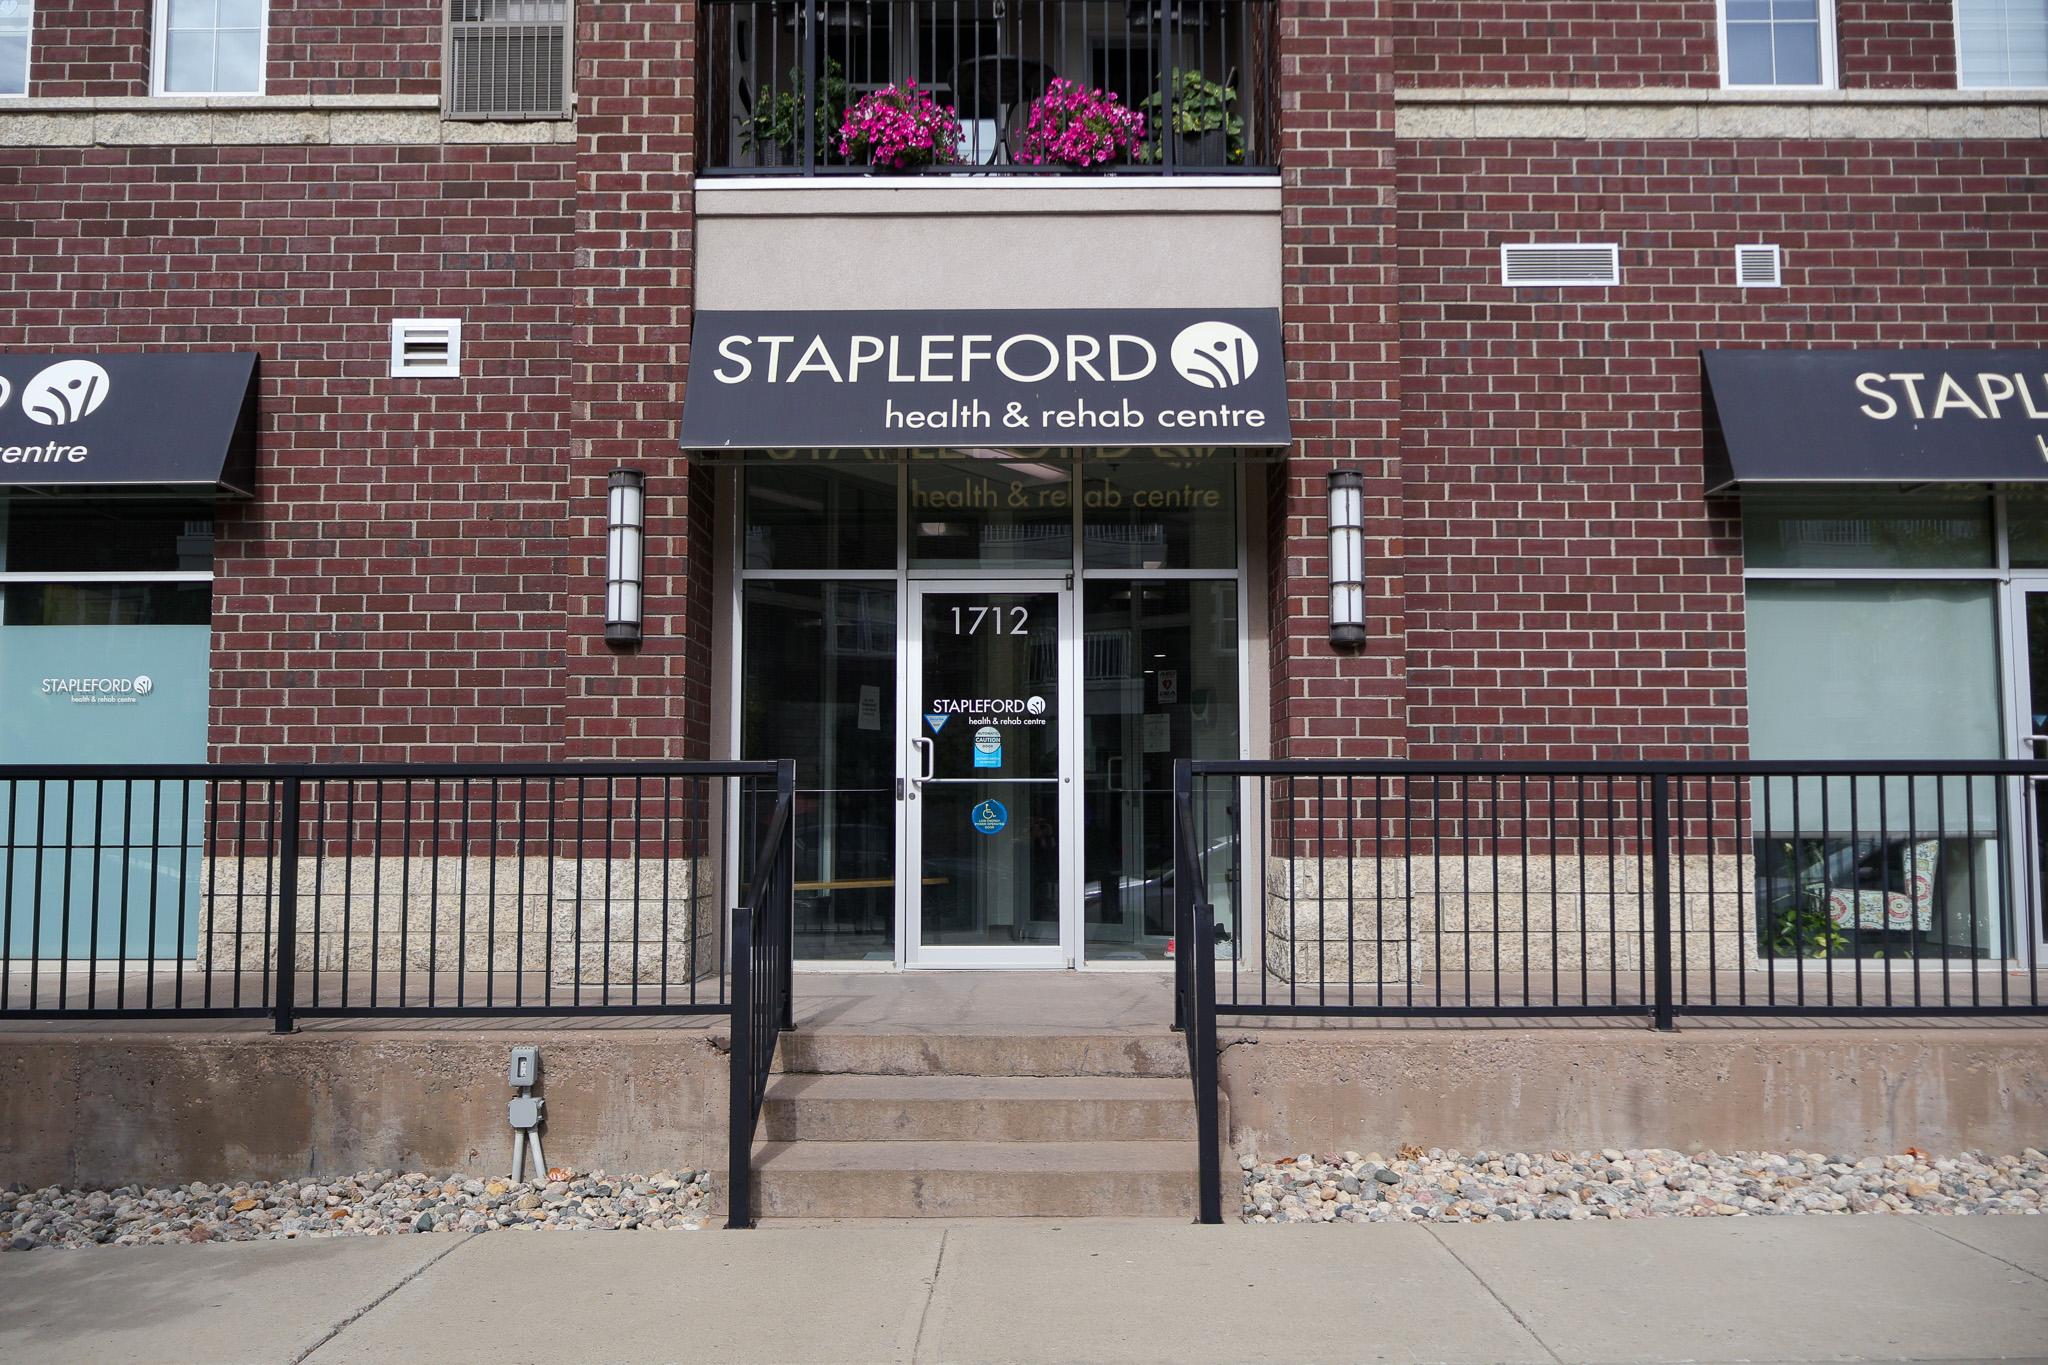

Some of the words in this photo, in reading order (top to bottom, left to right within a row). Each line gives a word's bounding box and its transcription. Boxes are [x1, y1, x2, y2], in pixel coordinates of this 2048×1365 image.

[713, 334, 1158, 384] STAPLEFORD
[1855, 371, 2048, 420] STAPL
[885, 399, 991, 429] health
[1003, 401, 1030, 428] &
[1042, 399, 1145, 428] rehab
[1157, 404, 1266, 428] centre
[0, 440, 88, 464] entre
[912, 478, 998, 507] health
[1133, 485, 1220, 507] centre
[951, 606, 1028, 635] 1712
[41, 678, 132, 693] STAPLEFORD
[71, 694, 90, 703] health
[98, 695, 116, 703] rehab
[933, 699, 1025, 714] STAPLEFORD
[968, 716, 991, 725] health
[992, 717, 999, 725] &
[1000, 716, 1022, 725] rehab
